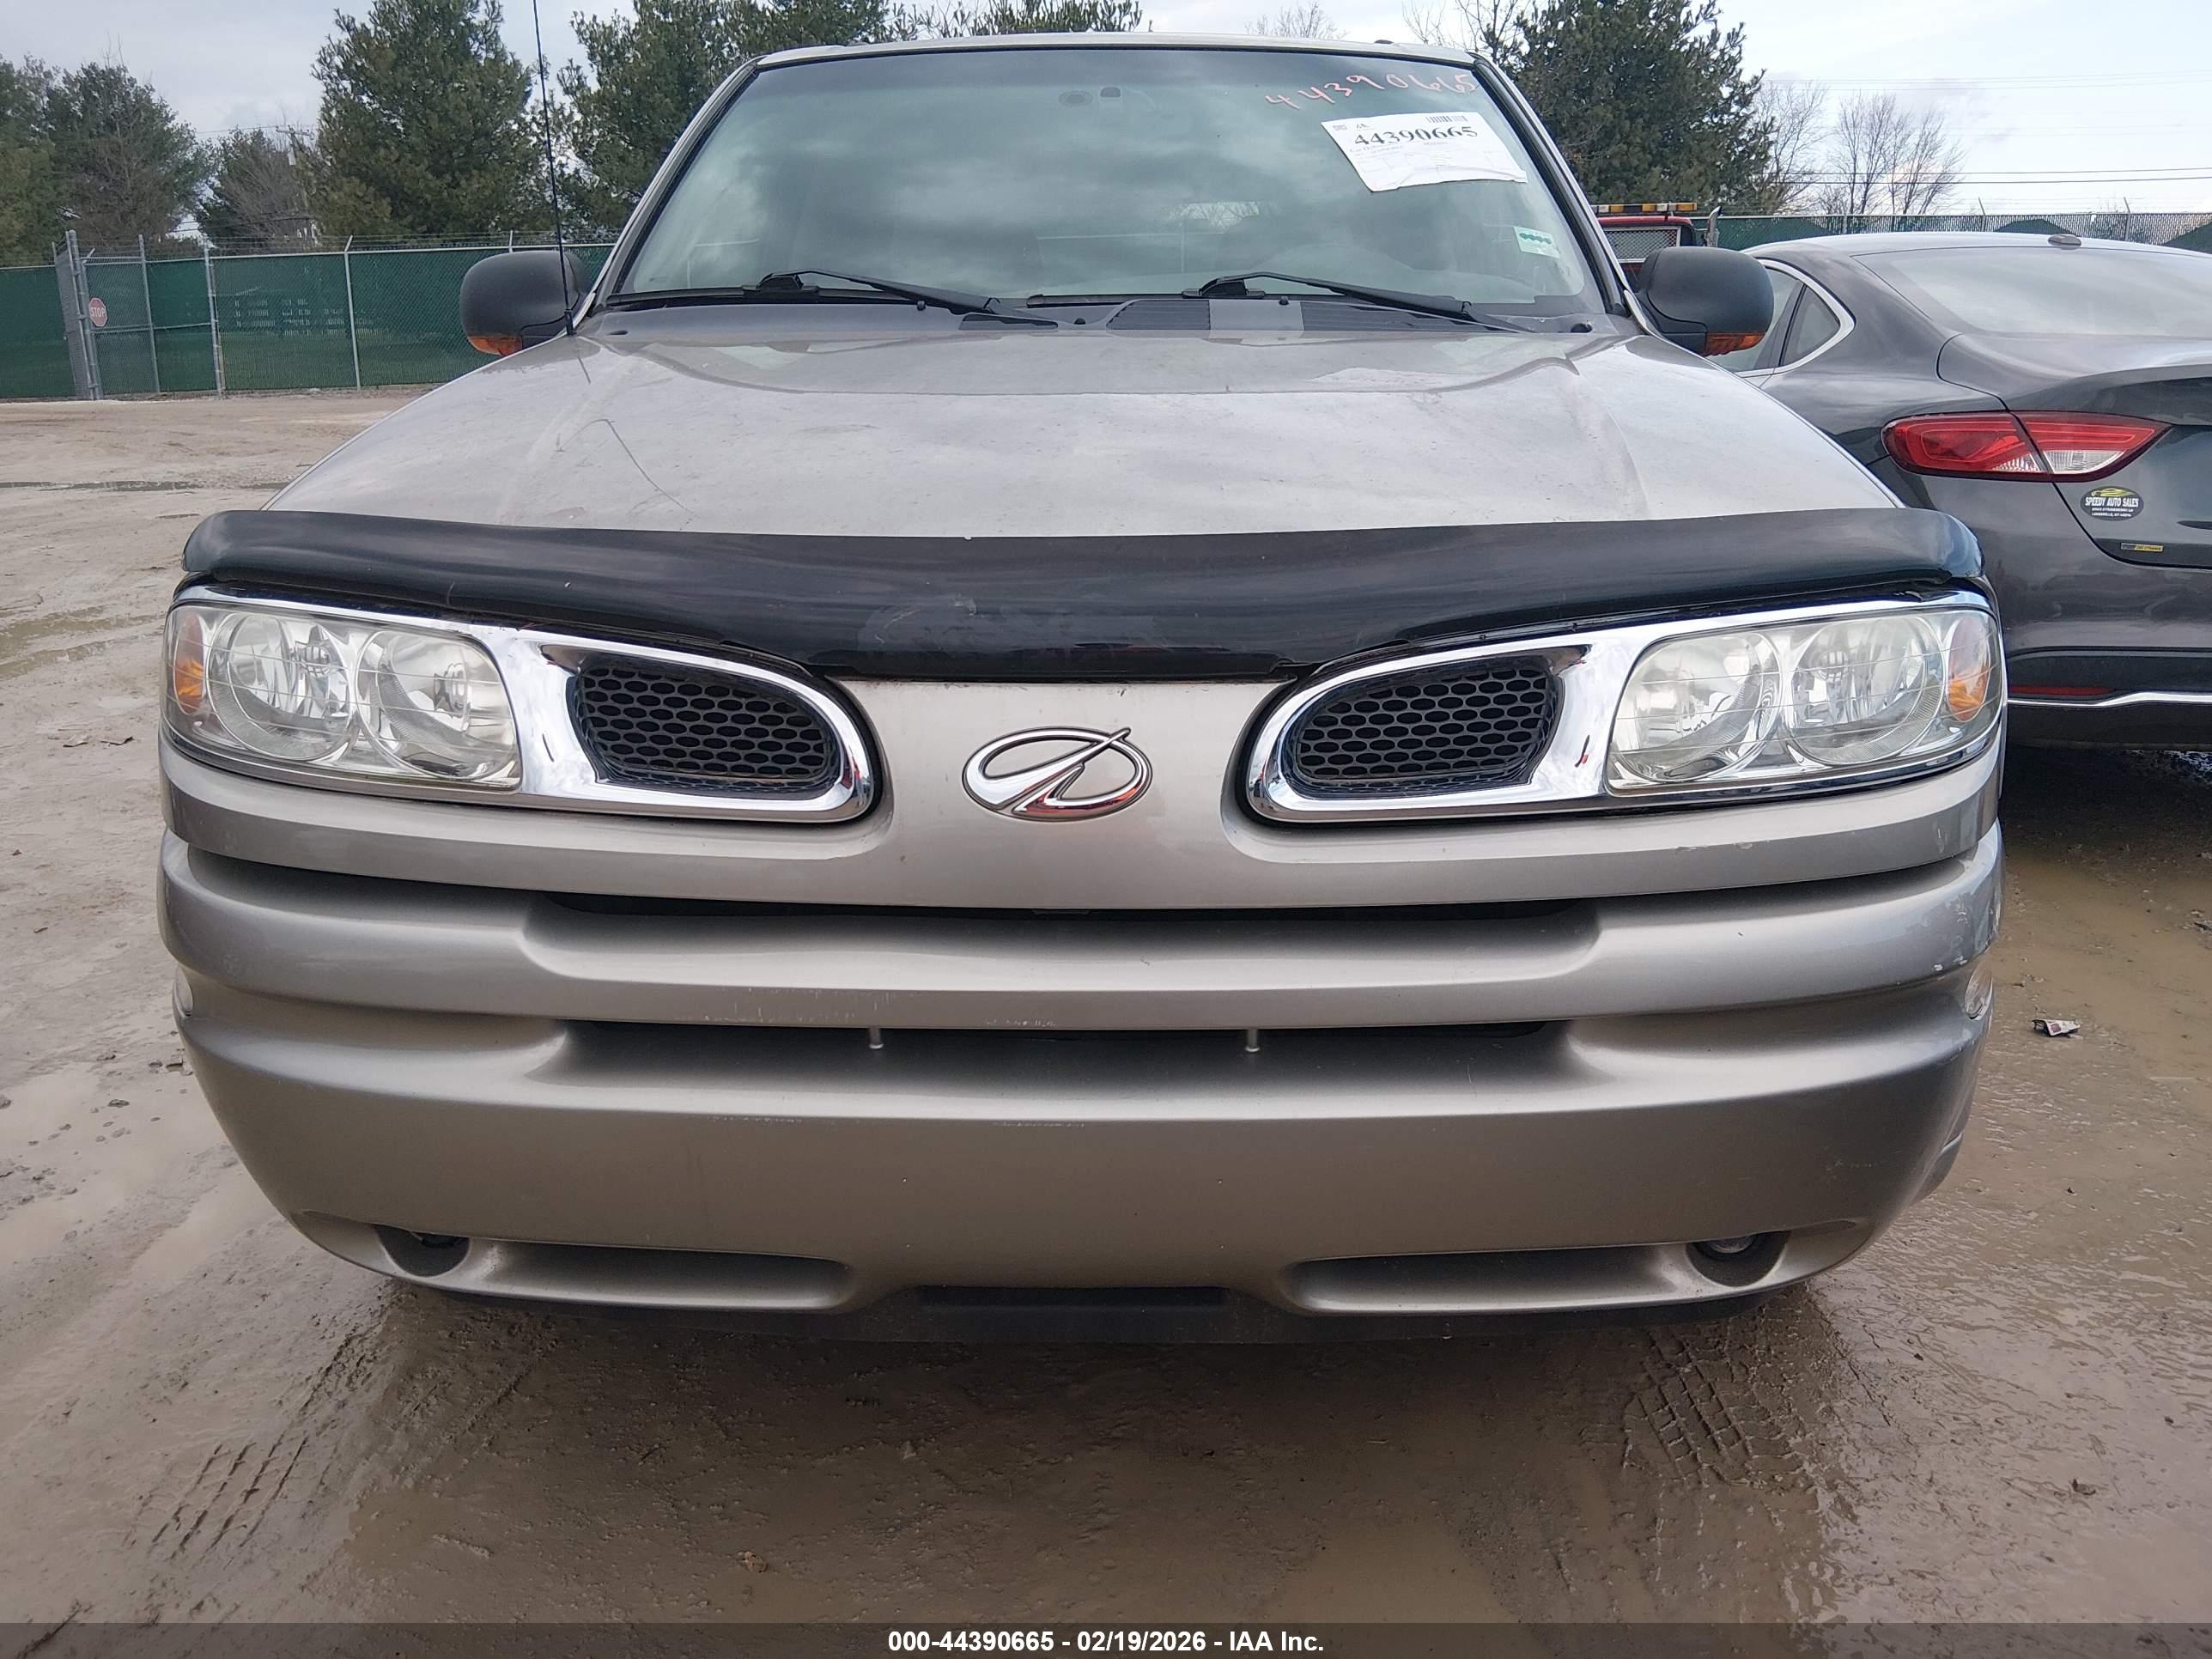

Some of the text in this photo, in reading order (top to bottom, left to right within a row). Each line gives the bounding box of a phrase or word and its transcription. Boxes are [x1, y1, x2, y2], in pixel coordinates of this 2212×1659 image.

[1265, 74, 1476, 110] 44390665
[1354, 125, 1479, 146] 44390665
[90, 307, 106, 318] STOP
[2085, 496, 2139, 507] SPEEDY AUTO SALES
